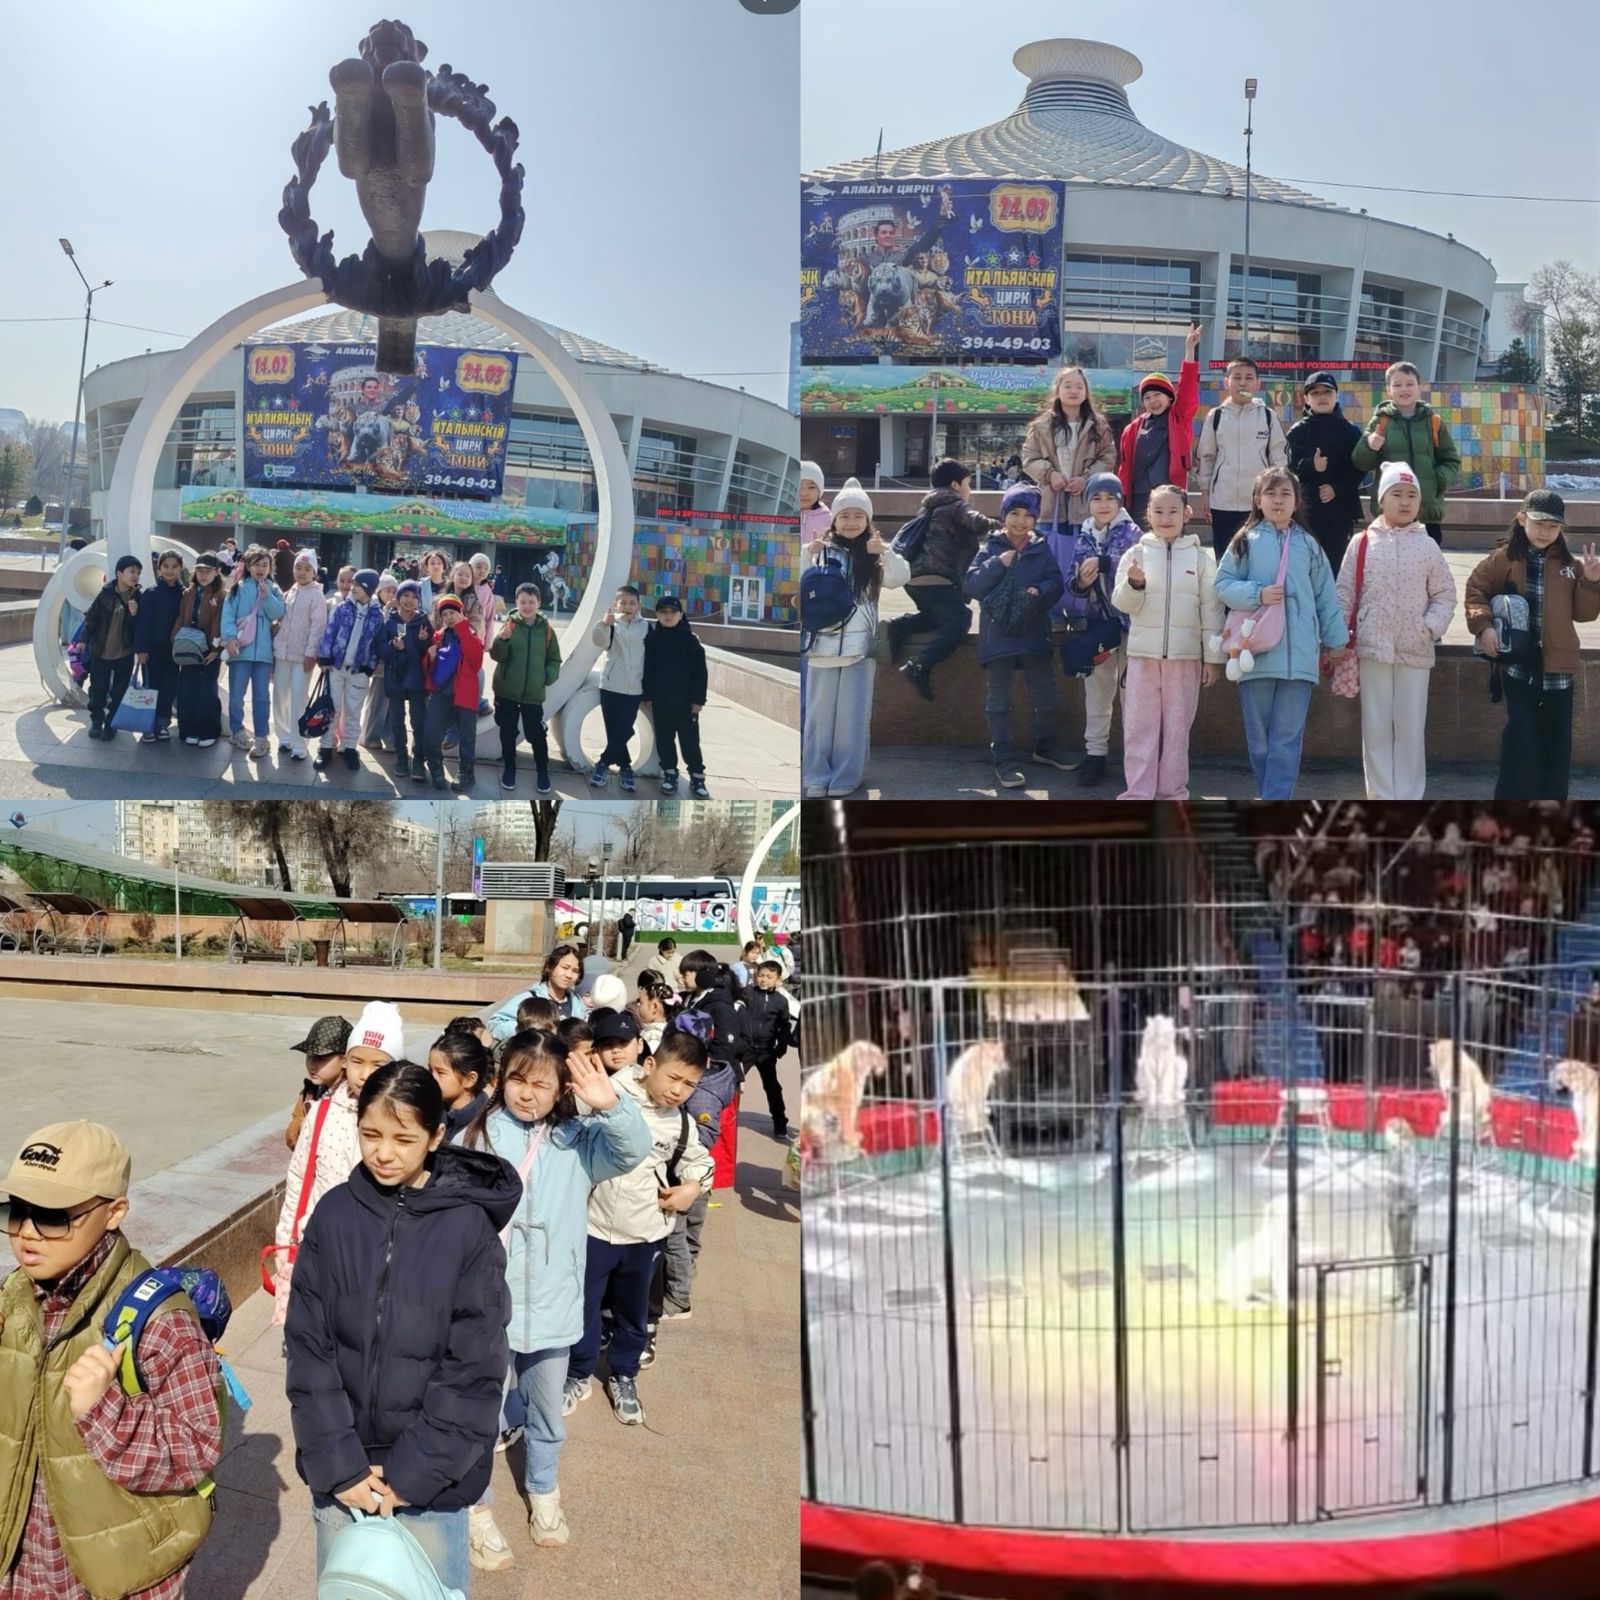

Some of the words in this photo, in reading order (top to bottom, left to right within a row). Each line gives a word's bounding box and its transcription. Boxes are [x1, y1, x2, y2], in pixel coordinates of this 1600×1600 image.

[841, 185, 893, 194] АЛМАТЫ
[998, 195, 1049, 221] 24.03
[966, 269, 1056, 287] ИТАЛЬЯНСКИЙ
[996, 291, 1029, 306] ЦИРК
[990, 309, 1037, 325] ТОНИ
[961, 337, 1051, 350] 394-49-03
[255, 355, 288, 375] 14.02
[464, 362, 504, 385] 24.03
[262, 443, 293, 456] ТОНИ
[456, 439, 481, 451] ЦИРК
[449, 454, 486, 468] ТОНИ
[424, 474, 497, 489] 394-49-03
